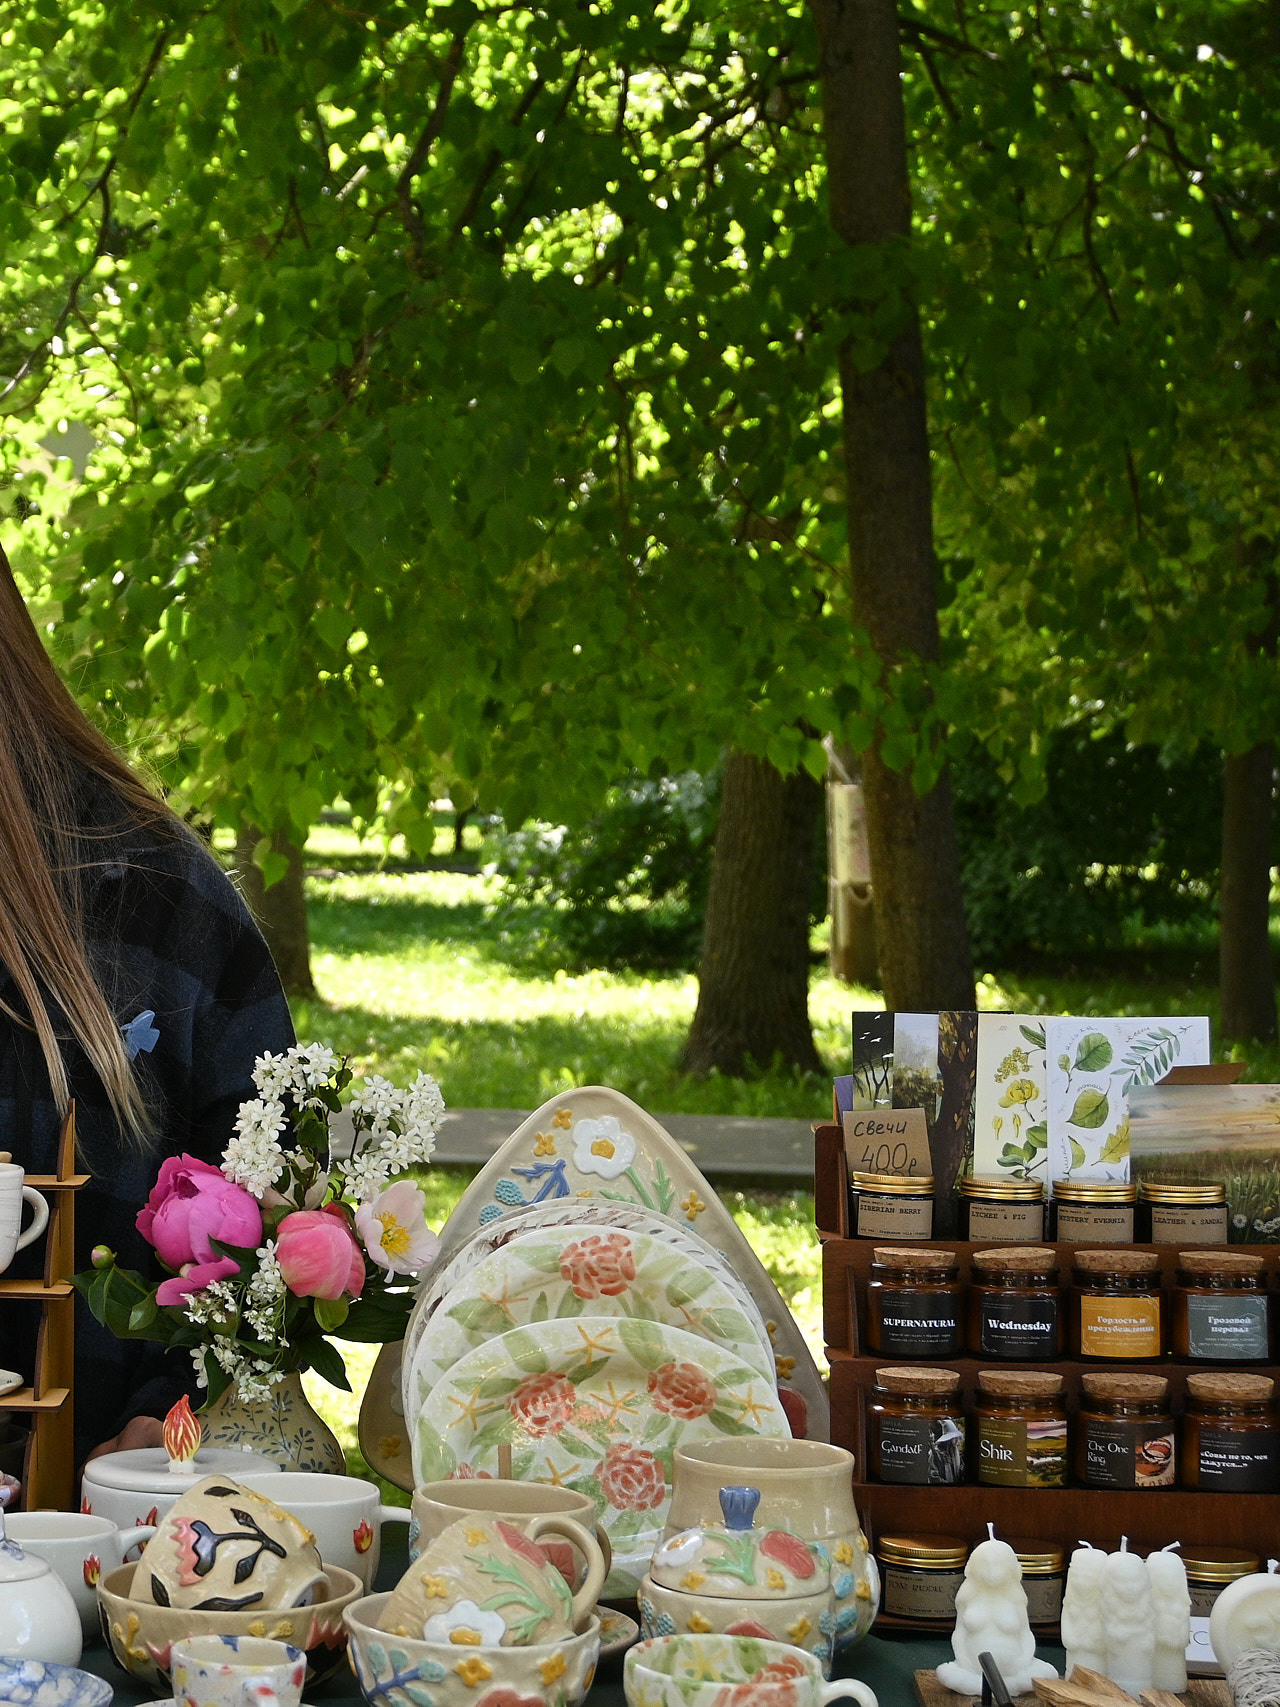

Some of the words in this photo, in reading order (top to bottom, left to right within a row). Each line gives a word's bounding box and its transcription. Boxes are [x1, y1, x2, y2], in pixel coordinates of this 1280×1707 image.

[854, 1120, 907, 1137] Свечи
[859, 1204, 895, 1214] SIBERIAN
[971, 1211, 999, 1220] LYCHEE
[1058, 1215, 1089, 1223] MYSTERY
[1153, 1216, 1186, 1225] LEATHER
[882, 1317, 956, 1328] SUPERNATURAL
[987, 1318, 1052, 1332] Wednesday
[1097, 1315, 1138, 1325] Гордость
[1207, 1316, 1252, 1325] Грозовой
[1087, 1325, 1155, 1334] предубеждение
[1211, 1326, 1249, 1334] перевал
[881, 1440, 923, 1455] Gandalf
[1087, 1439, 1106, 1452] The
[1107, 1442, 1129, 1454] One
[1087, 1451, 1106, 1467] Ring
[888, 1580, 908, 1590] TOM
[912, 1584, 944, 1593] RIDDLE
